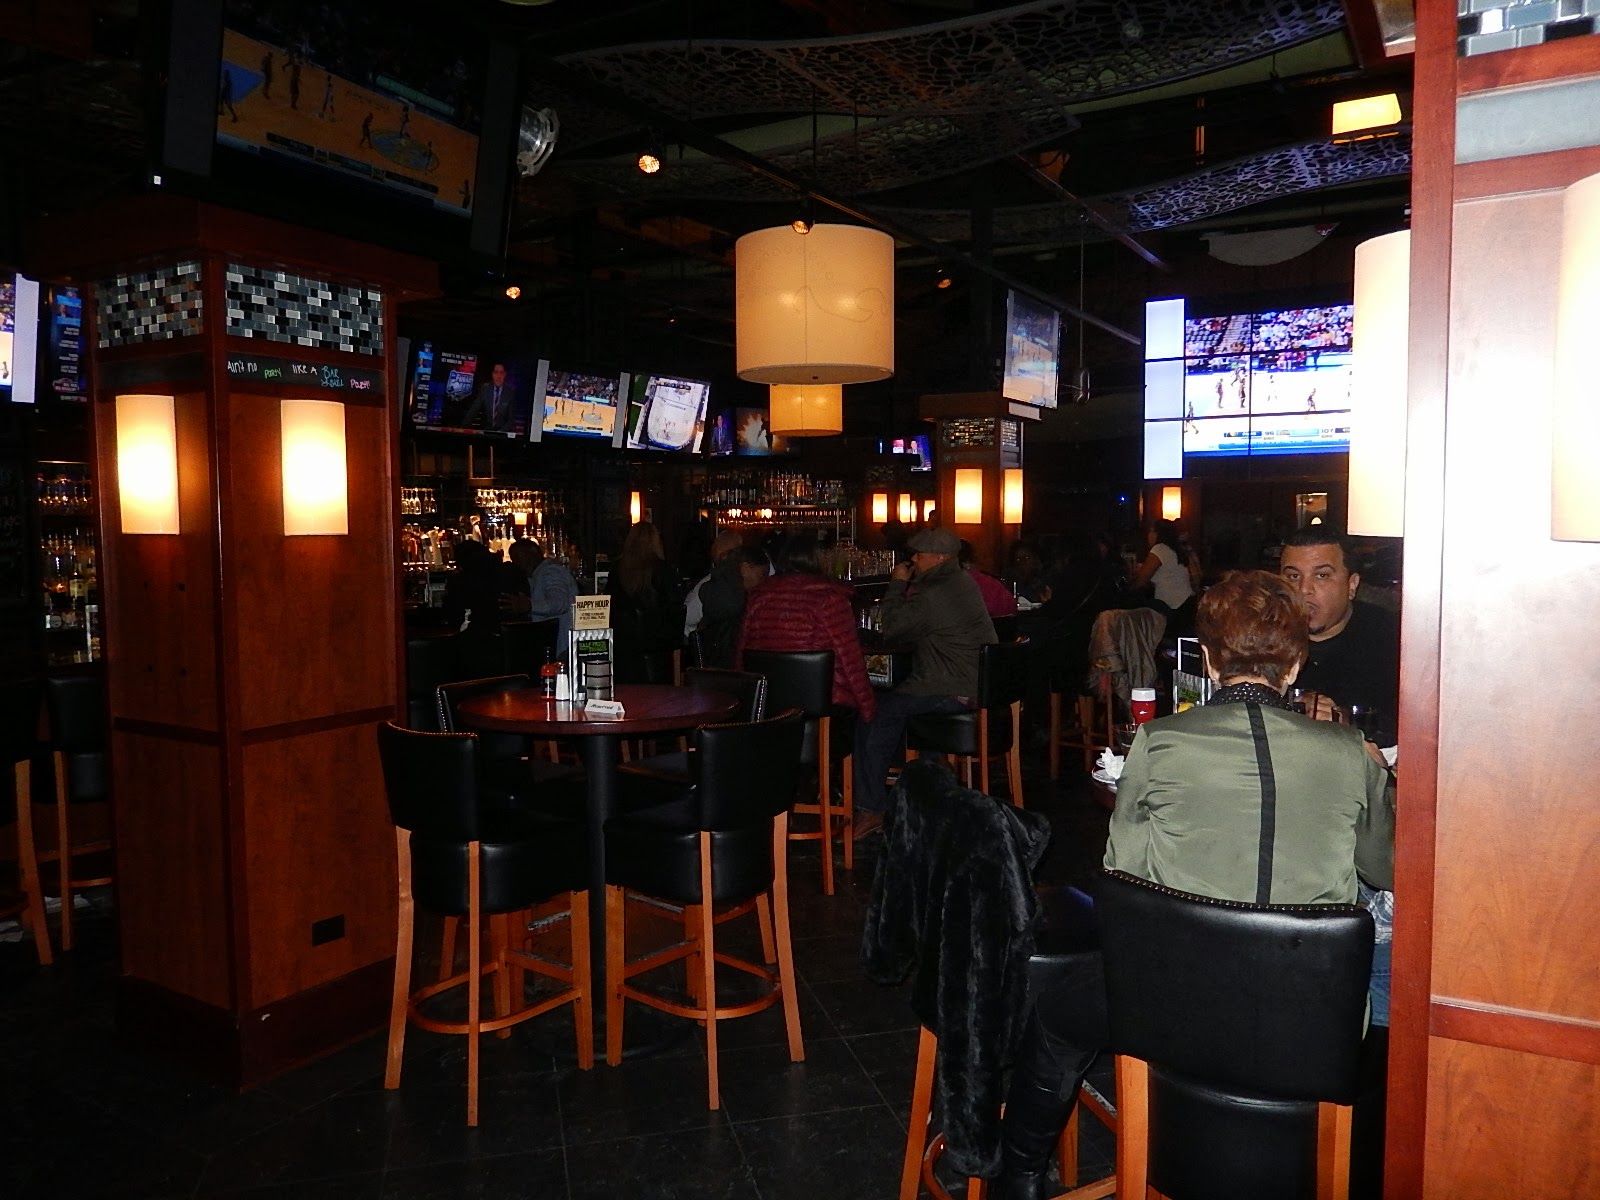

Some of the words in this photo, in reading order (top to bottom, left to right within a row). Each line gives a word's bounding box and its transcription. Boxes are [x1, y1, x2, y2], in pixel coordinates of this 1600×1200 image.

[227, 360, 245, 373] Ain't
[247, 362, 258, 373] no
[576, 600, 595, 609] HAPPY
[595, 599, 610, 608] HOUR
